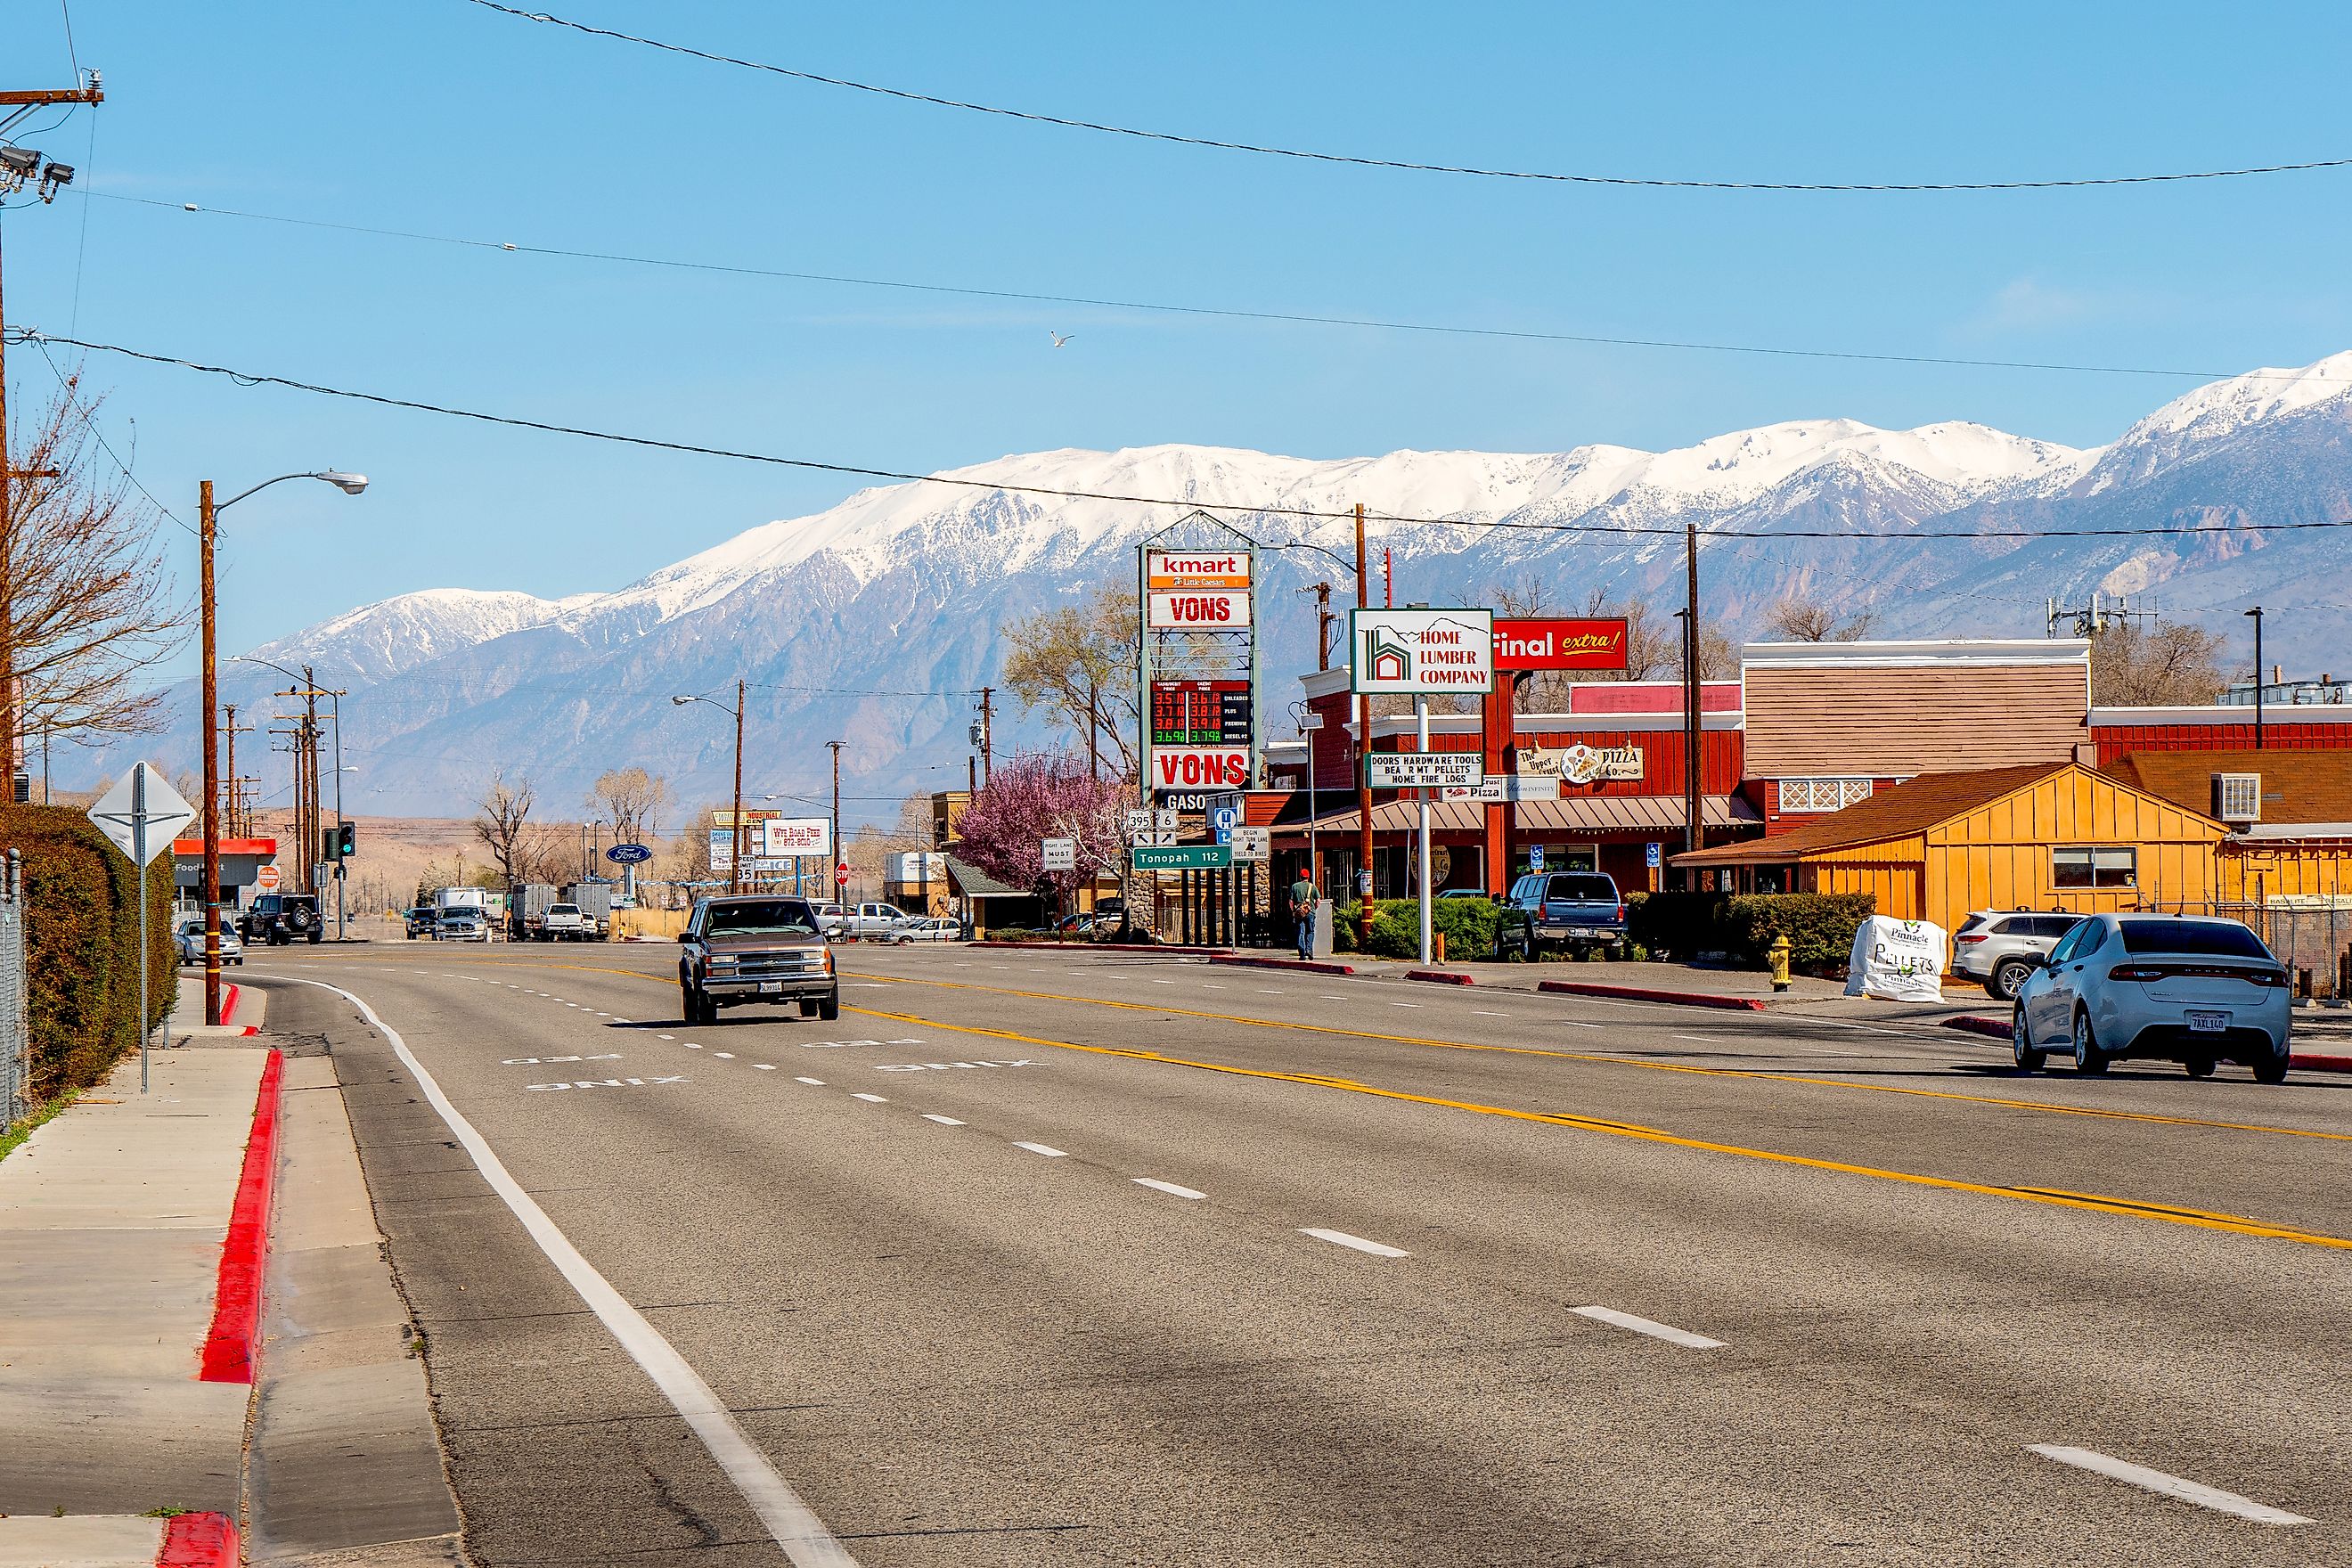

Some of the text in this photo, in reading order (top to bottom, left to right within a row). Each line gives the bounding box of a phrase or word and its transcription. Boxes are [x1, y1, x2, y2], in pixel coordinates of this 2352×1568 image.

[1164, 557, 1236, 572] kmart
[1184, 578, 1226, 586] Little Caesars
[1170, 597, 1230, 621] VONS
[1420, 631, 1462, 645] HOME
[1562, 630, 1621, 650] extra!
[1420, 650, 1477, 665] LUMBER
[1420, 670, 1488, 684] COMPANY
[1372, 755, 1482, 765] DOORS HARDWARE TOOLS
[1519, 751, 1535, 763] The
[1602, 751, 1638, 764] PIZZA
[1160, 754, 1245, 785] VONS
[1435, 765, 1471, 774] PELLETS
[1529, 757, 1552, 771] Upper
[1392, 774, 1466, 784] HOME FIRE LOGS
[1470, 787, 1499, 797] Pizza
[1131, 816, 1149, 827] 395
[1164, 815, 1172, 826] 6
[615, 848, 641, 860] Ford
[1139, 852, 1219, 864] Tonopah 112
[175, 862, 200, 872] Food
[770, 861, 791, 870] ICE
[837, 870, 849, 879] STP
[1891, 927, 1929, 943] Pinnacle
[2192, 1018, 2224, 1029] 7AXL140
